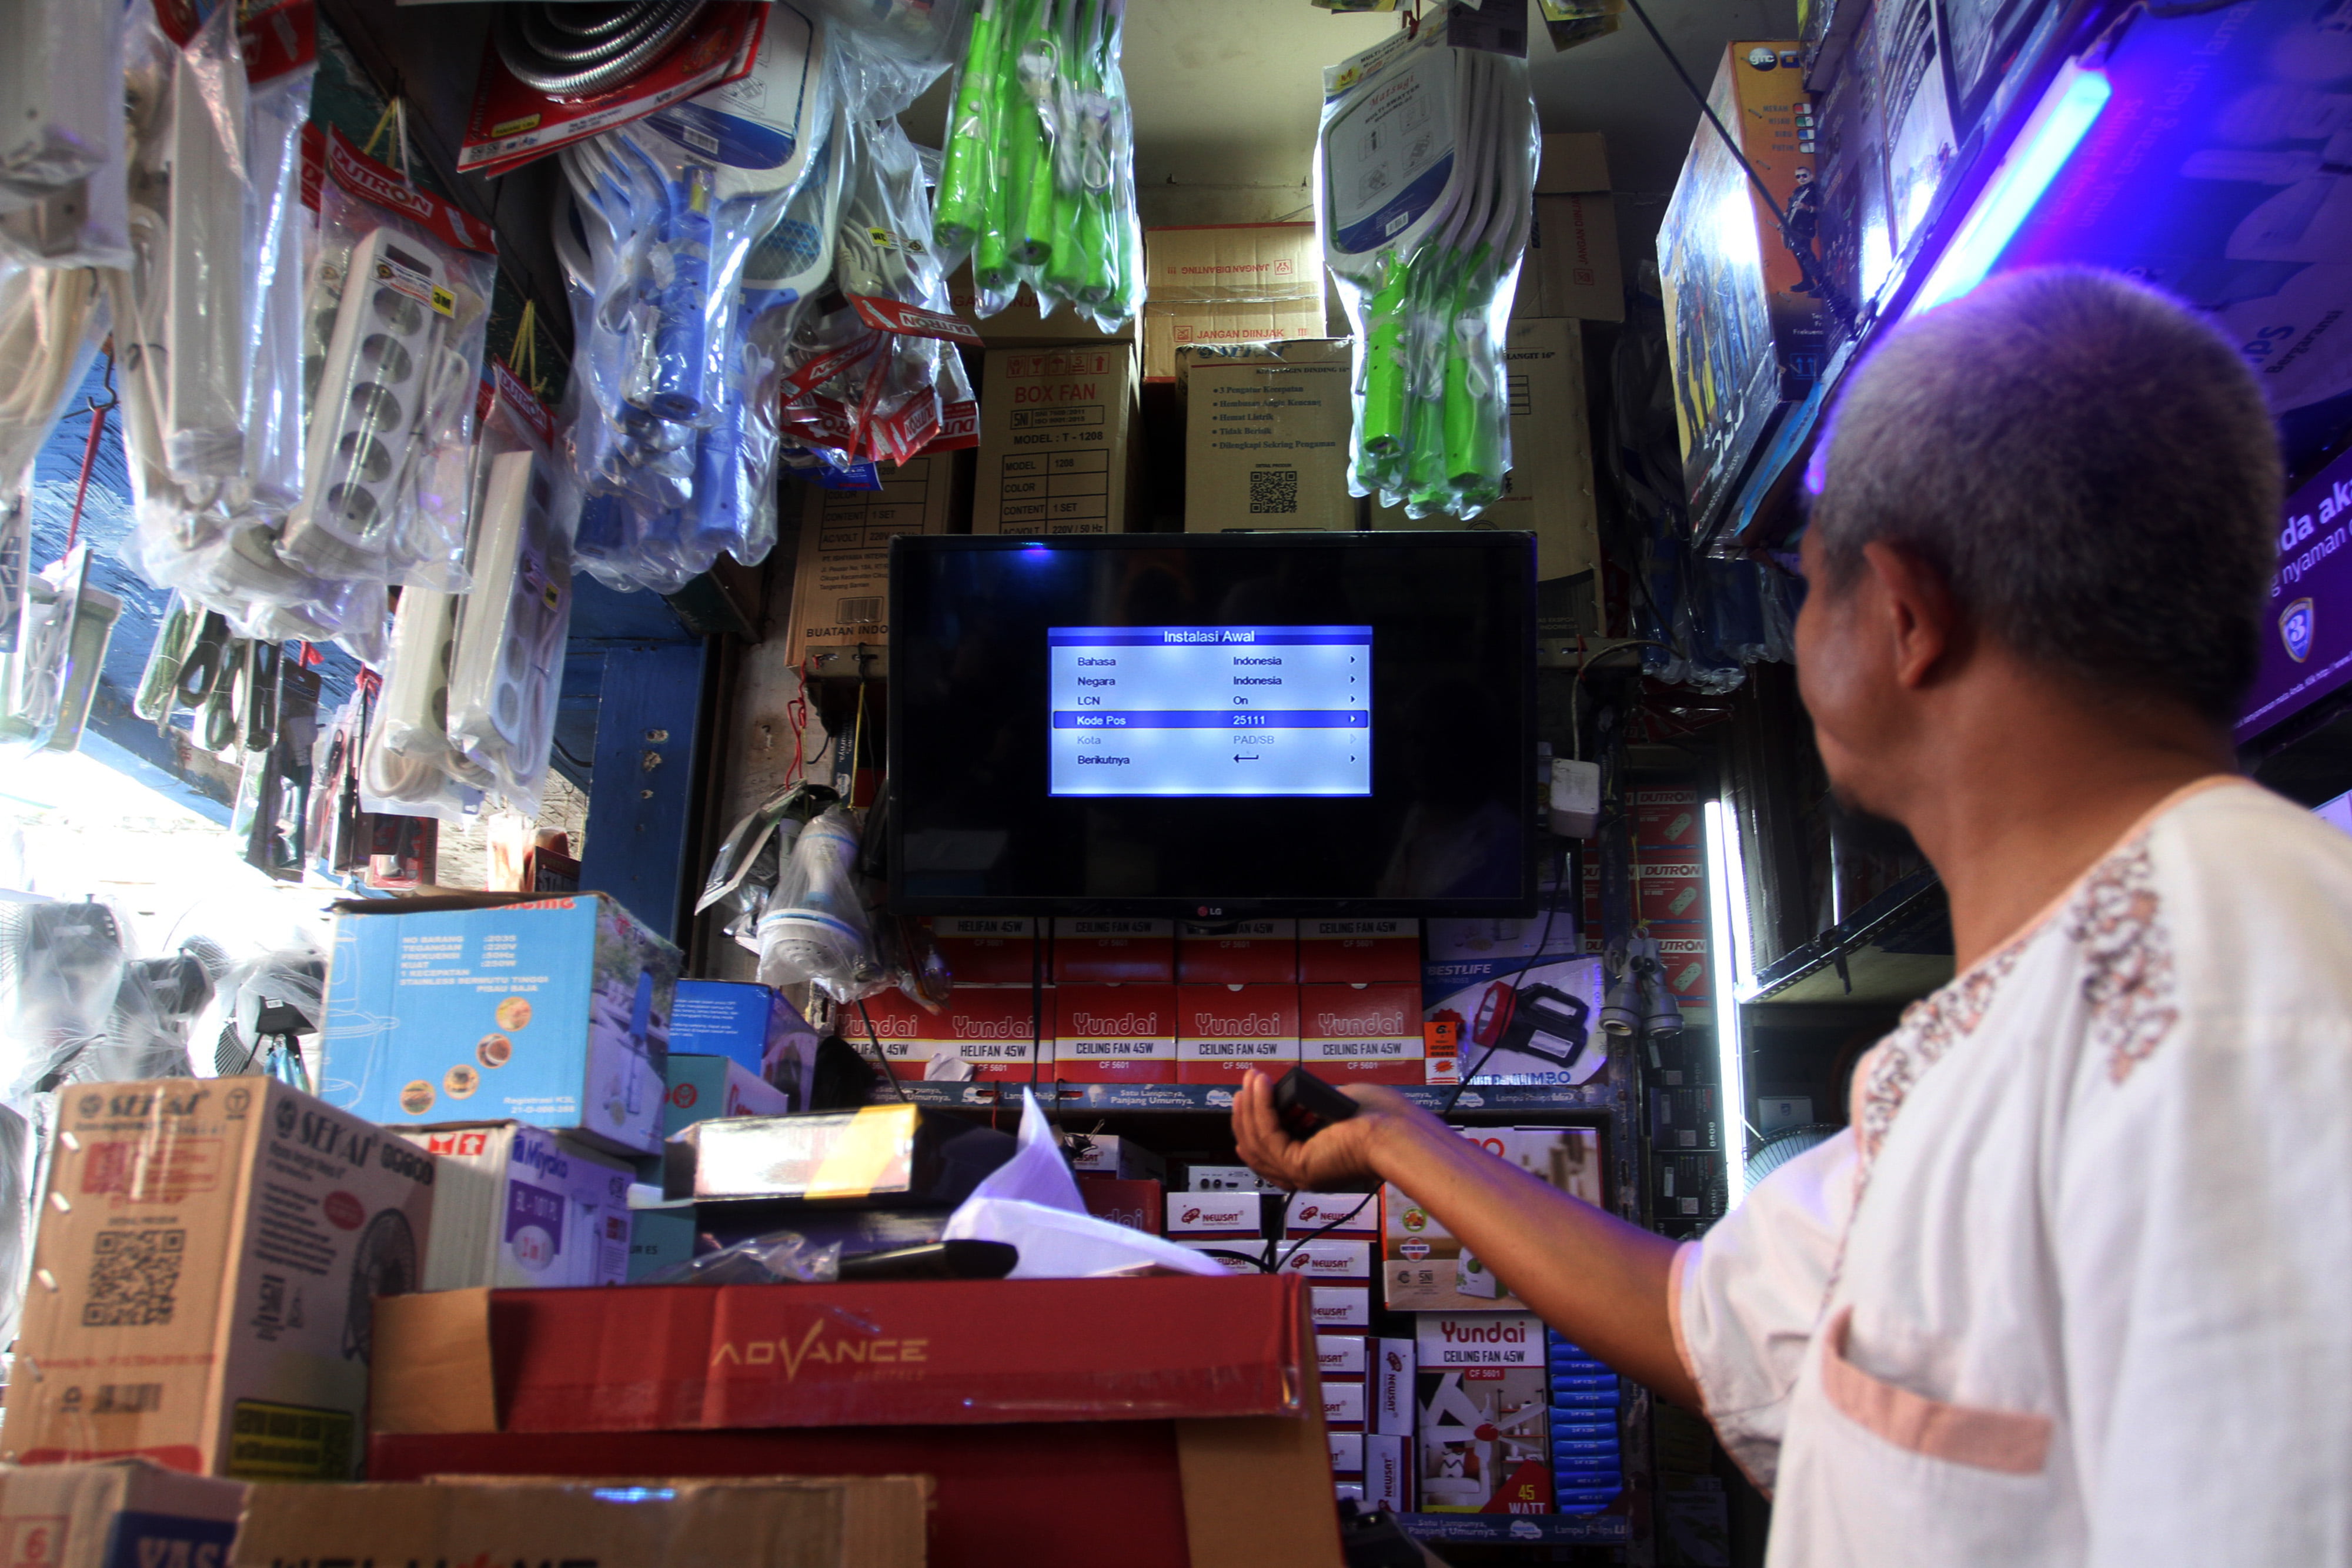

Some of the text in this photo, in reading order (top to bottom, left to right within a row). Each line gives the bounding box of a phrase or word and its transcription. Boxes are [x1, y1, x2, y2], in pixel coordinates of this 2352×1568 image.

[332, 145, 433, 216] DUTRON
[1182, 266, 1232, 275] DIBANTING
[902, 313, 973, 336] DUTRON
[1197, 329, 1284, 339] JANGAN DIINJAK
[2264, 309, 2343, 374] Bergaransi
[1014, 383, 1096, 403] BOX FAN
[1227, 386, 1261, 394] Pengatur
[1264, 386, 1303, 394] Kecepatan
[1288, 399, 1321, 407] Kencang
[1014, 413, 1028, 427] SNI
[1014, 434, 1053, 445] MODEL
[1079, 432, 1104, 441] 1208
[1220, 440, 1335, 450] Dilengkapi Sekring Pengaman
[1005, 459, 1074, 471] MODEL 1208
[1005, 483, 1035, 493] COLOR
[825, 510, 896, 521] CONTENT SET
[1004, 503, 1077, 516] CONTENT SET
[823, 533, 858, 543] AC/VOLT
[2283, 527, 2346, 583] nyaman
[806, 624, 890, 638] BUATAN INDO
[1164, 631, 1255, 643] Instalasi Awal
[1077, 656, 1282, 666] Bahasa Indonesia
[1077, 676, 1282, 687] Negara Indonesia
[1077, 696, 1248, 706] LCN On
[1077, 715, 1265, 726] Kode Pos 25111
[1077, 734, 1275, 745] Kota PAD/SB
[1077, 754, 1130, 766] Berikutnya
[1640, 792, 1695, 803] DUTRON
[1645, 865, 1700, 875] DUTRON
[957, 921, 1023, 932] HELIFAN 45W
[1075, 921, 1152, 932] CEILING FAN 45W
[1253, 923, 1274, 933] 45W
[1319, 922, 1397, 933] CEILING FAN 45W
[1426, 964, 1492, 976] BESTLIFE
[837, 1014, 918, 1037] Yundai
[952, 1015, 1034, 1038] Yundai
[1073, 1012, 1157, 1035] Yundai
[1195, 1012, 1280, 1036] Yundai
[1318, 1012, 1403, 1035] Yundai
[887, 1044, 908, 1055] 45W
[961, 1045, 1026, 1057] HELIFAN 45W
[1076, 1042, 1154, 1054] CEILING FAN 45W
[1199, 1042, 1277, 1055] CEILING FAN 45W
[1323, 1042, 1401, 1055] CEILING FAN 45W
[1141, 1089, 1185, 1098] Lampunya,
[1111, 1096, 1195, 1106] Panjang Umurnya.
[1202, 1213, 1238, 1222] NEWSAT
[1312, 1259, 1348, 1268] NEWSAT
[1441, 1321, 1525, 1343] Yundai
[711, 1318, 929, 1383] ADVANCE
[1444, 1350, 1525, 1362] CEILING FAN 45W
[1469, 1369, 1501, 1378] CF 5601
[1387, 1374, 1396, 1412] NEWSAT
[1384, 1458, 1393, 1497] NEWSAT
[1518, 1485, 1535, 1500] 45
[1509, 1503, 1545, 1514] WATT
[1409, 1527, 1446, 1537] Panjang
[1451, 1527, 1498, 1537] Umurnya.
